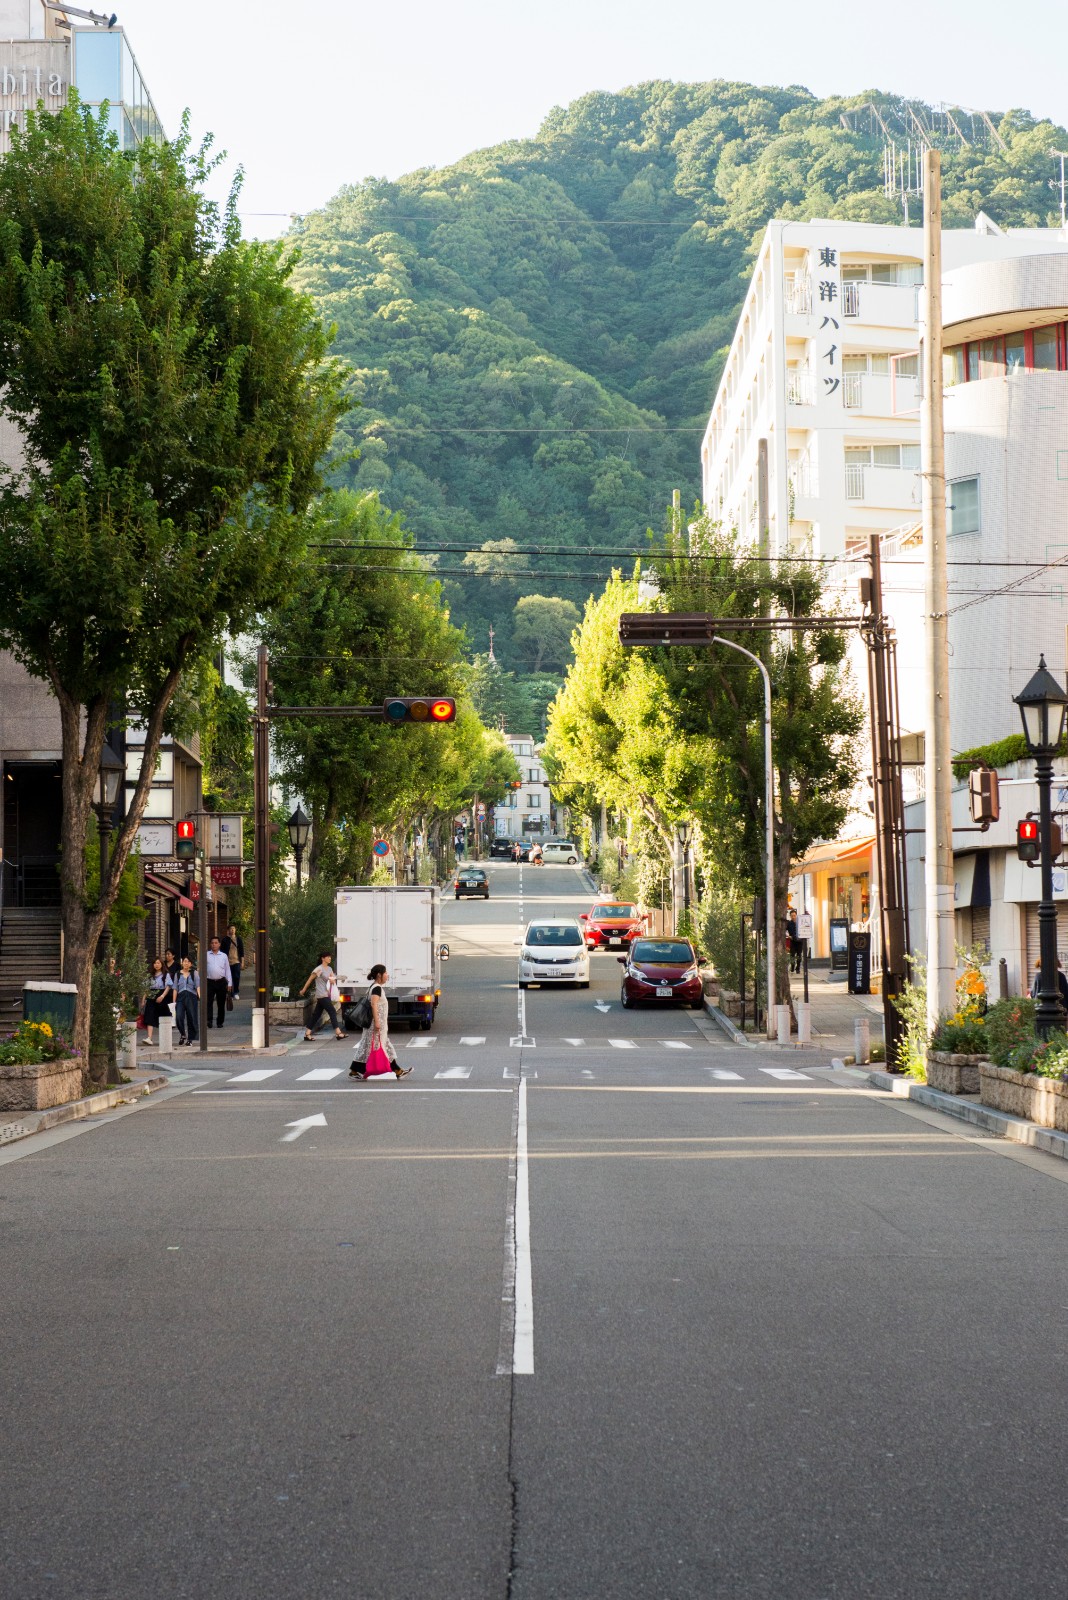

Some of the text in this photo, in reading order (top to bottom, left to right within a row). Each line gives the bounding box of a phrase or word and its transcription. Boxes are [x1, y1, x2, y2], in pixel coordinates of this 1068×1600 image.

[818, 247, 840, 396] 東洋ハイツ
